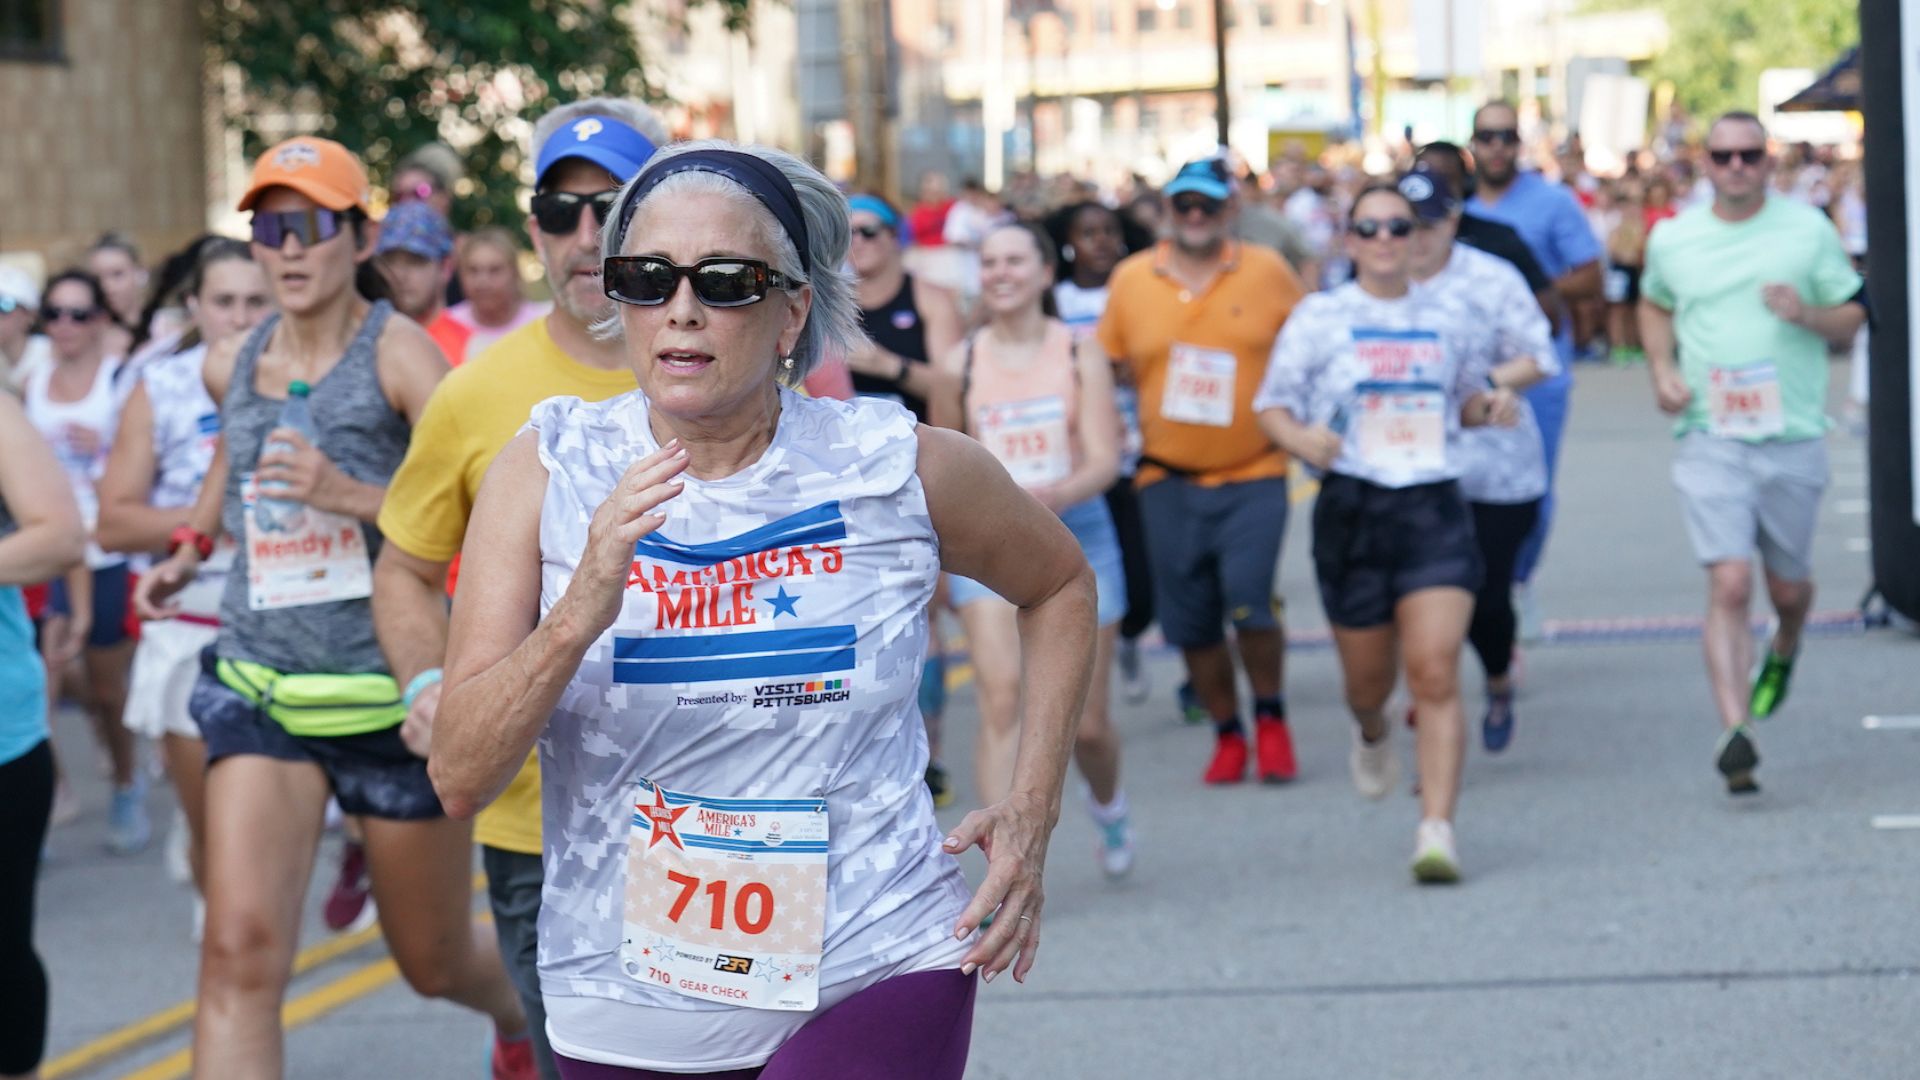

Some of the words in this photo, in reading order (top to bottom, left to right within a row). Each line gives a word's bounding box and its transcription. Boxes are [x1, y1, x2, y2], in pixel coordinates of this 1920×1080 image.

[572, 118, 603, 141] P
[255, 530, 332, 557] Wendy
[655, 583, 757, 630] MILE
[754, 683, 805, 696] VISIT
[677, 693, 728, 706] Presented
[729, 692, 747, 705] by:
[753, 690, 850, 709] PITTSBURGH
[697, 809, 756, 827] AMERICA'S
[704, 823, 731, 838] MILE
[667, 869, 774, 934] 710
[675, 951, 704, 962] POWERED
[648, 967, 671, 984] 710
[679, 979, 708, 993] GEAR
[711, 985, 749, 1000] CHECK
